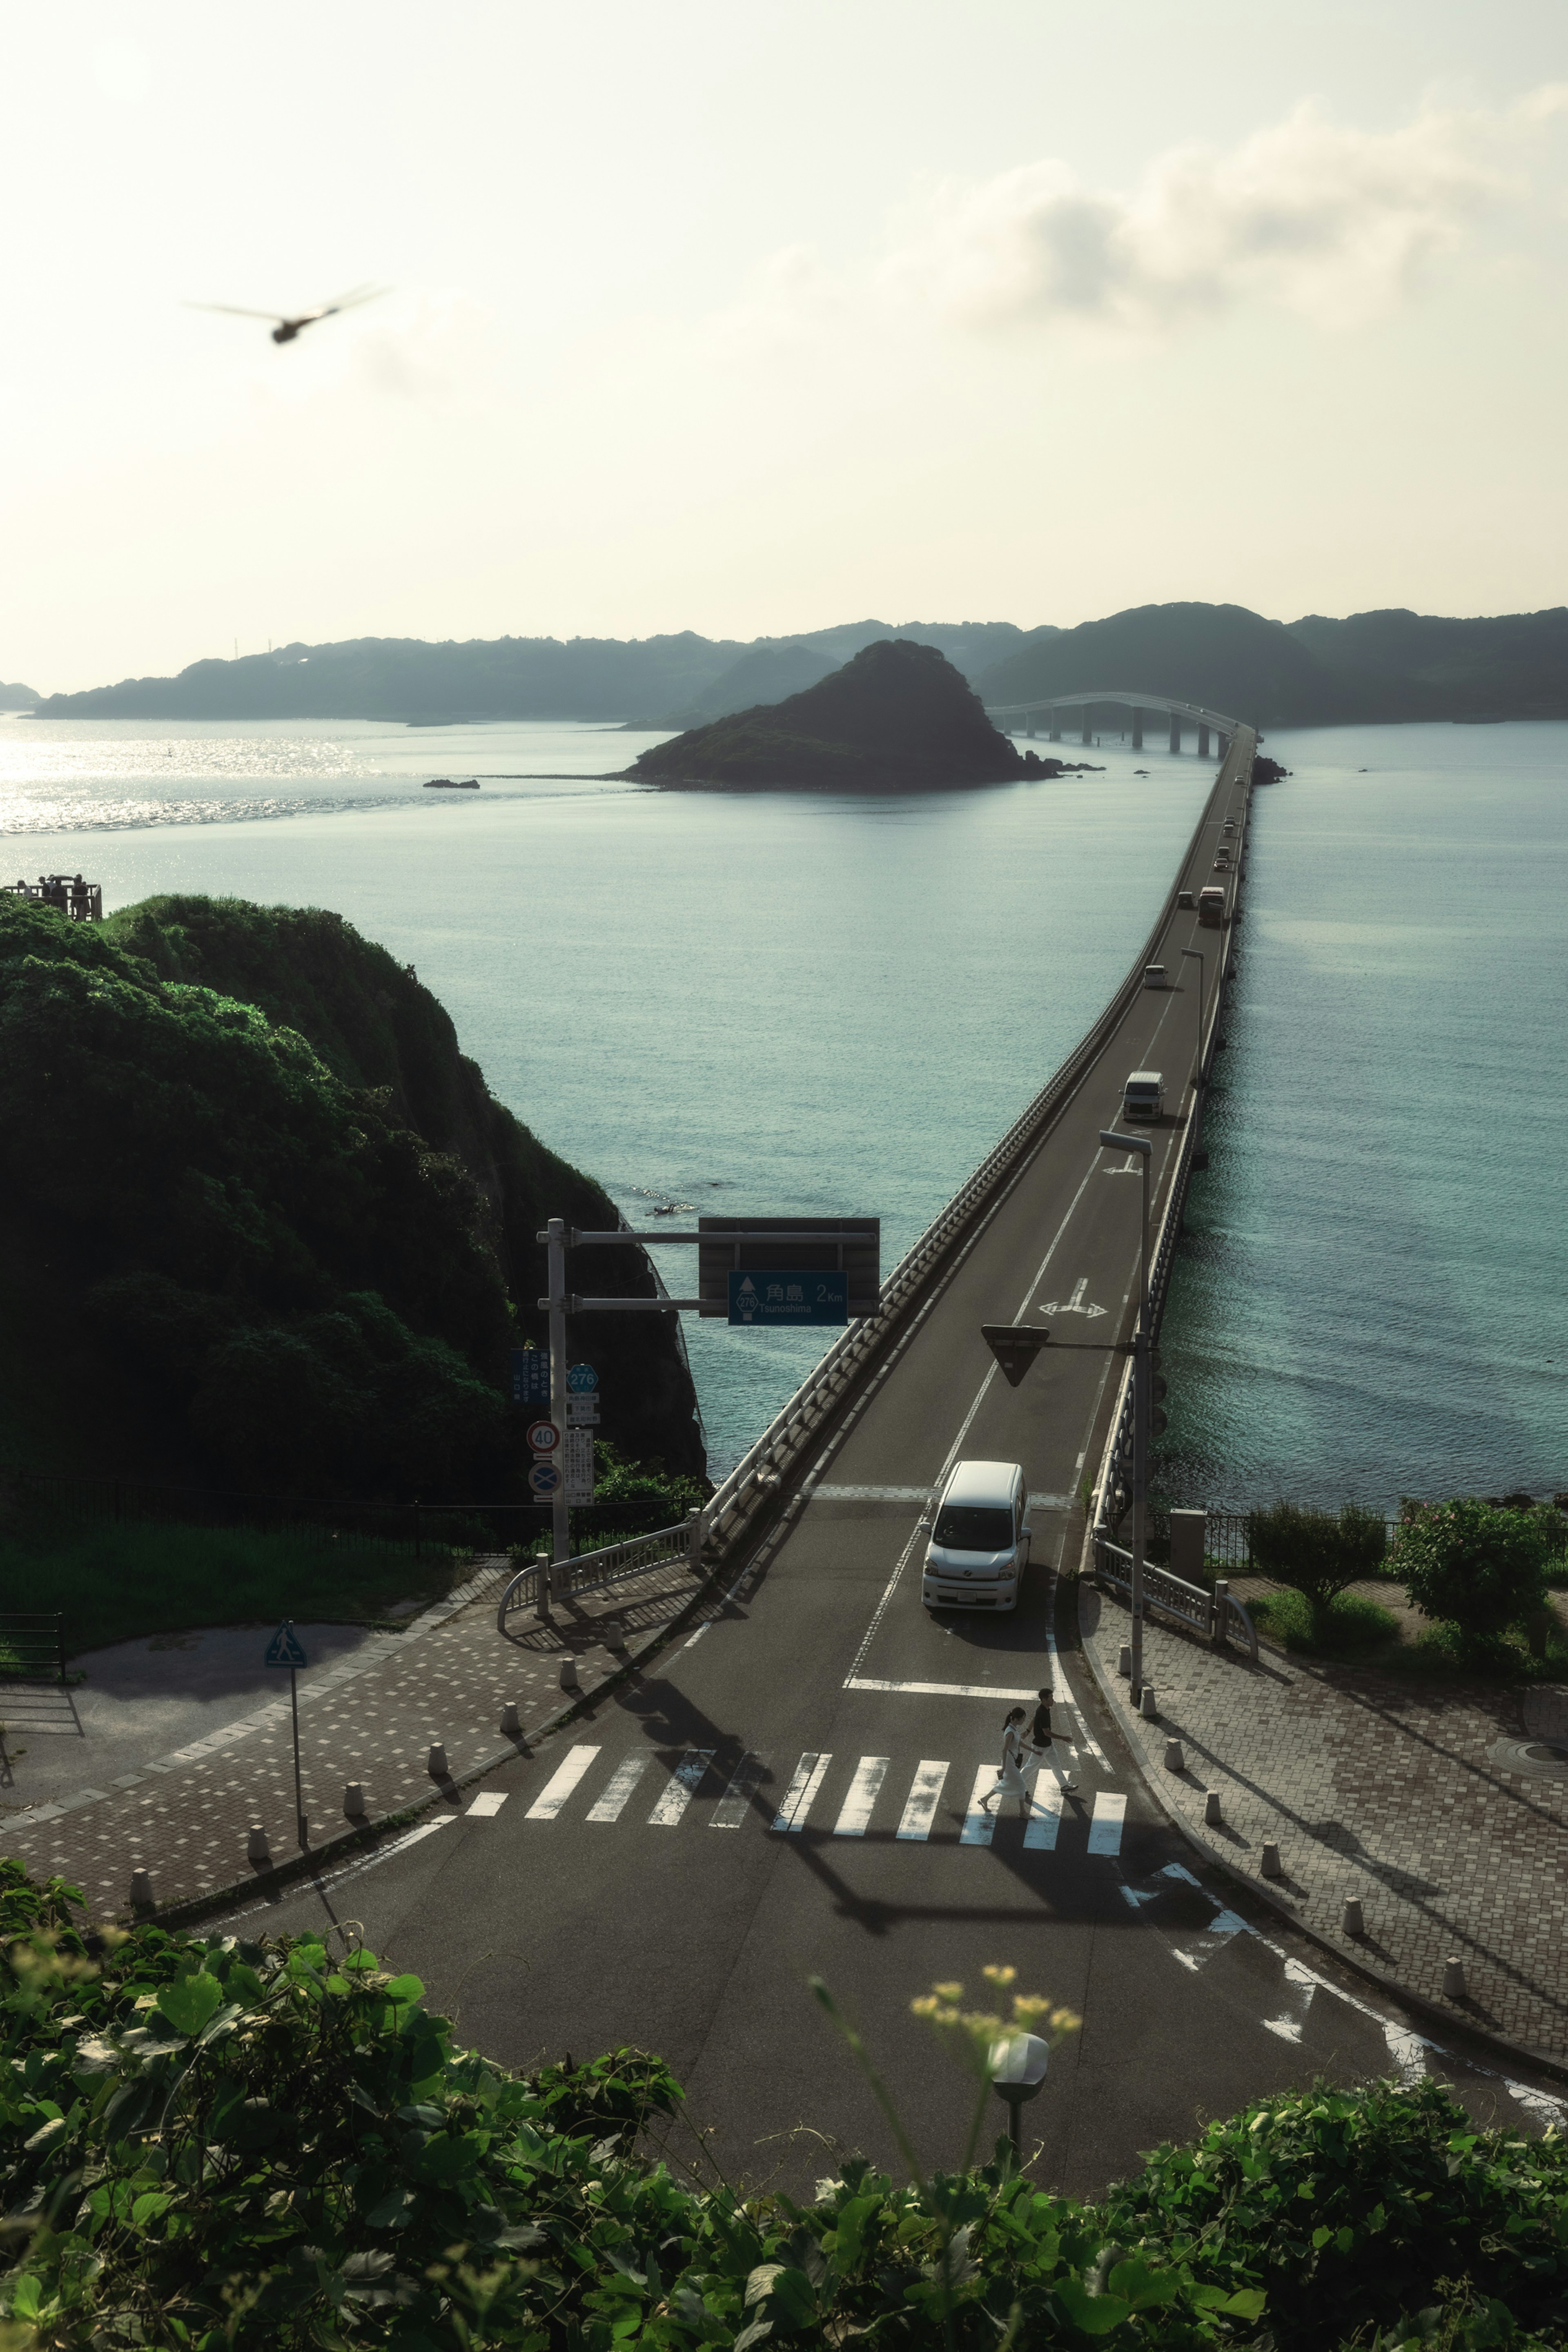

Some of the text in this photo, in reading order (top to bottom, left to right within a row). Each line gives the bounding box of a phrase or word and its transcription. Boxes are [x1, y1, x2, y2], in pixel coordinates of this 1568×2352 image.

[766, 1284, 804, 1302] 角島
[740, 1298, 755, 1307] 276
[759, 1303, 811, 1313] Tsunoshima
[540, 1352, 548, 1397] 強風のとき
[570, 1374, 594, 1385] 276
[535, 1430, 553, 1444] 40
